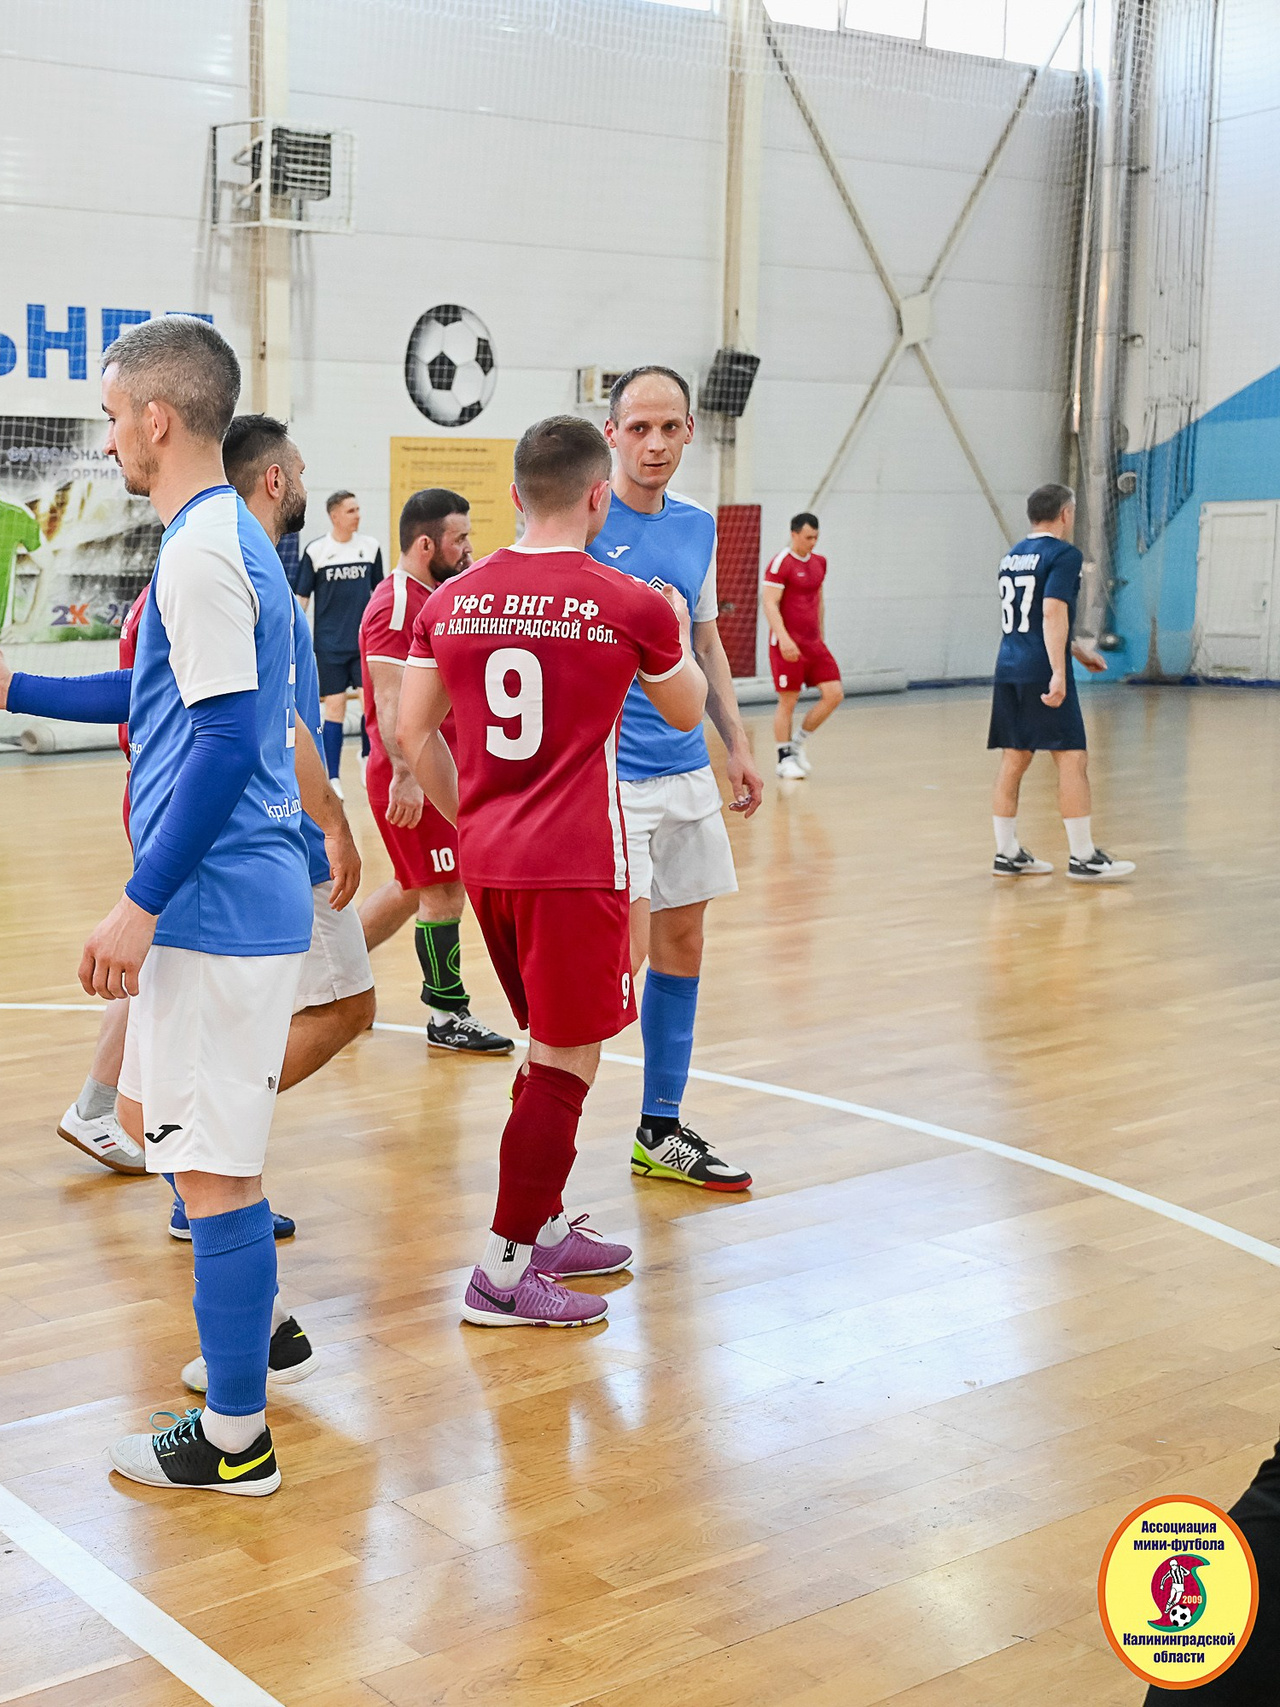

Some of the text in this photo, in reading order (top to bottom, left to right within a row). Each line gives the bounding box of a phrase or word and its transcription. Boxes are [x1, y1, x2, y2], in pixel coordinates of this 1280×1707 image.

[325, 565, 368, 582] FARBY
[451, 593, 599, 621] УФС ВНГ РФ
[998, 573, 1036, 635] 87
[434, 618, 618, 645] по КАЛИНИНГРАДСКОЙ обл.
[485, 648, 544, 760] 9
[430, 847, 456, 873] 10
[622, 972, 631, 1010] 9
